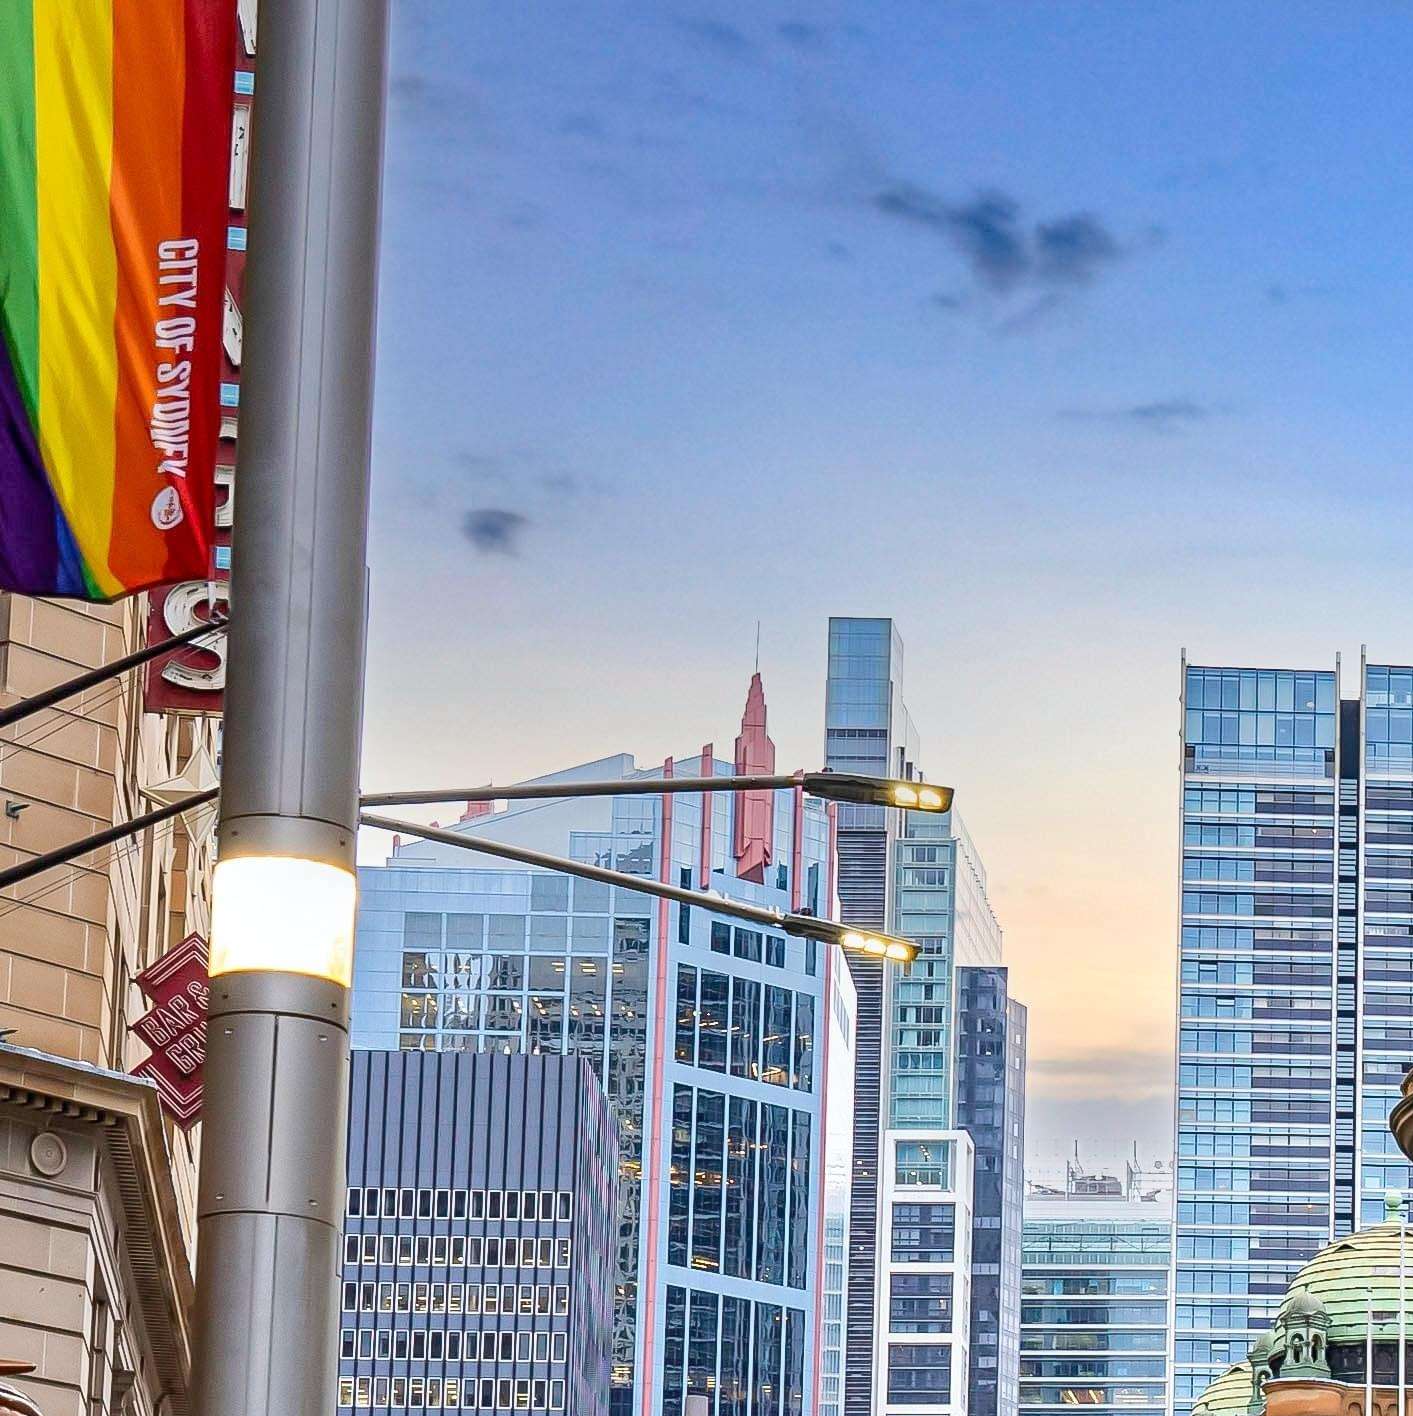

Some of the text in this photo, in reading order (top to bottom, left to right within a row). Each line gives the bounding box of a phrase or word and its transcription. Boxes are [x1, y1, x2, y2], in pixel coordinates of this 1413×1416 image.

[158, 238, 199, 308] CITY
[155, 316, 196, 354] OF
[141, 994, 200, 1047] BAR
